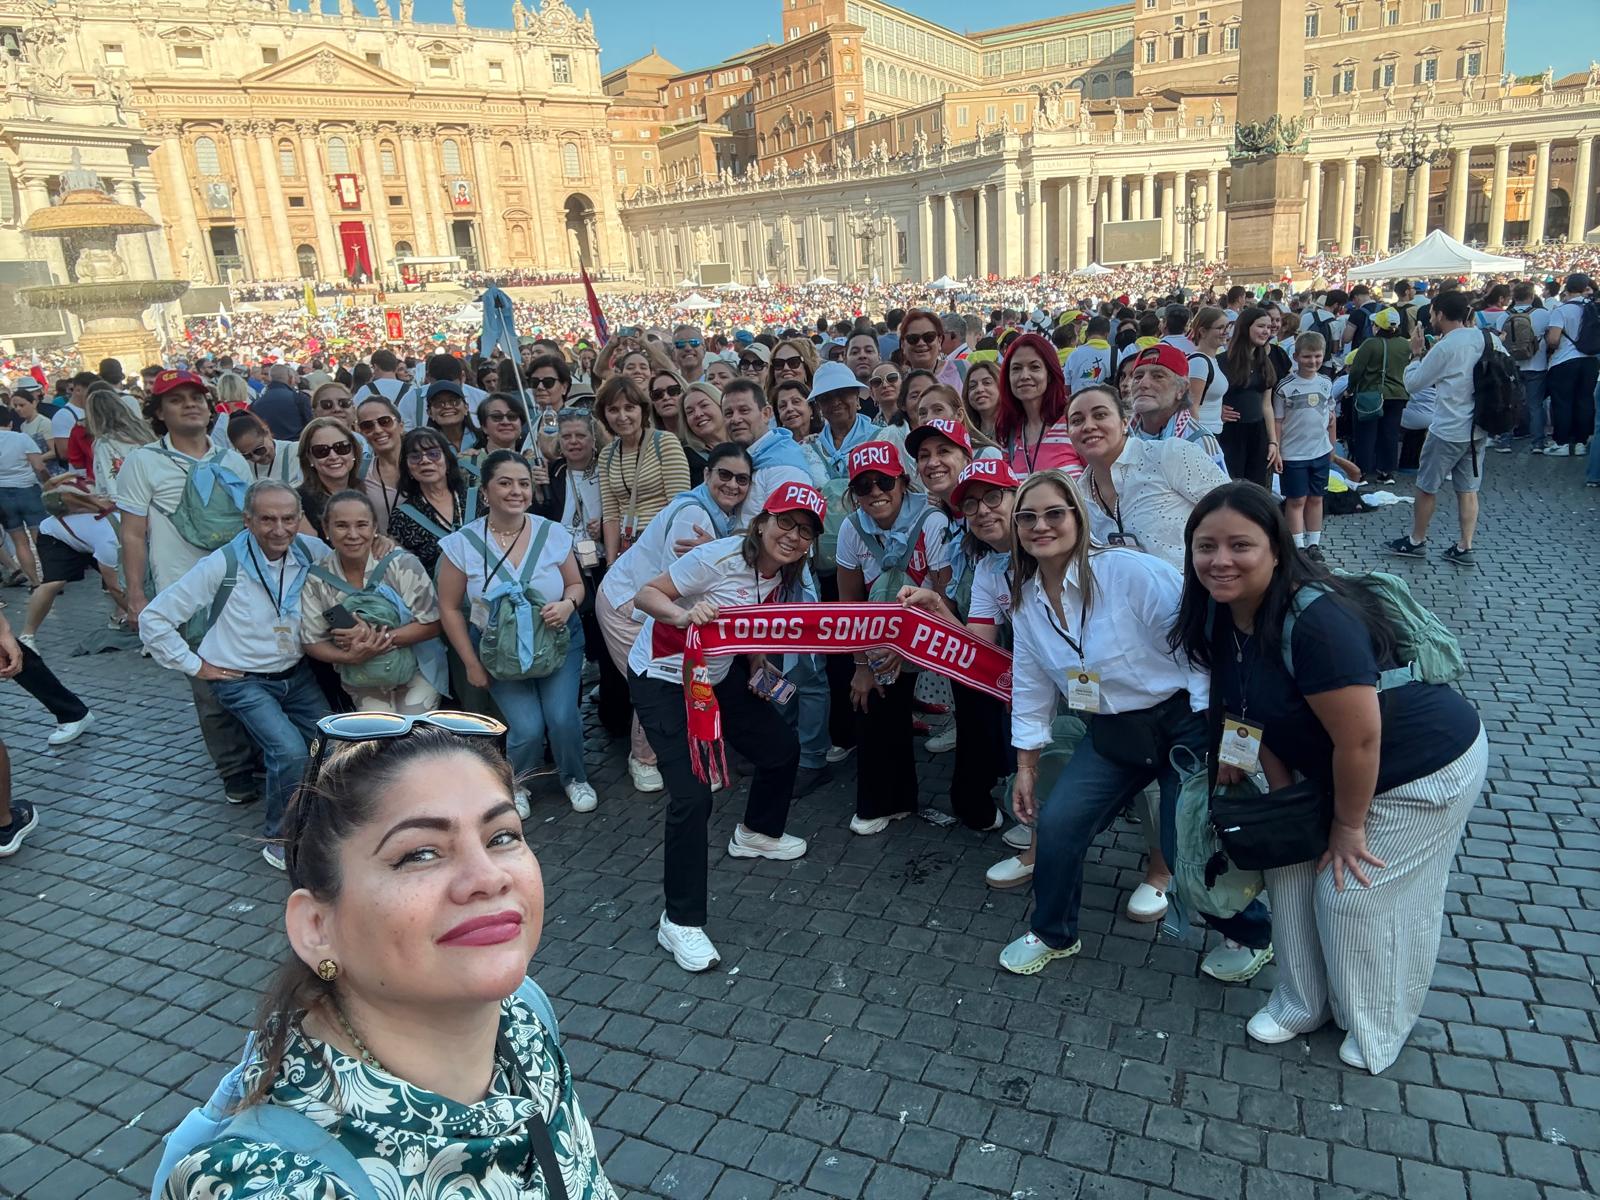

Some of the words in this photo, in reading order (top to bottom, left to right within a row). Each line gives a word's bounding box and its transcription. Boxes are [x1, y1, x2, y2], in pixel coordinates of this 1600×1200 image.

[852, 446, 889, 470] PERÚ
[958, 461, 997, 484] PERÚ
[785, 486, 824, 513] PERÚ
[716, 617, 804, 640] TODOS
[817, 616, 903, 640] SOMOS
[909, 623, 976, 669] PERÚ
